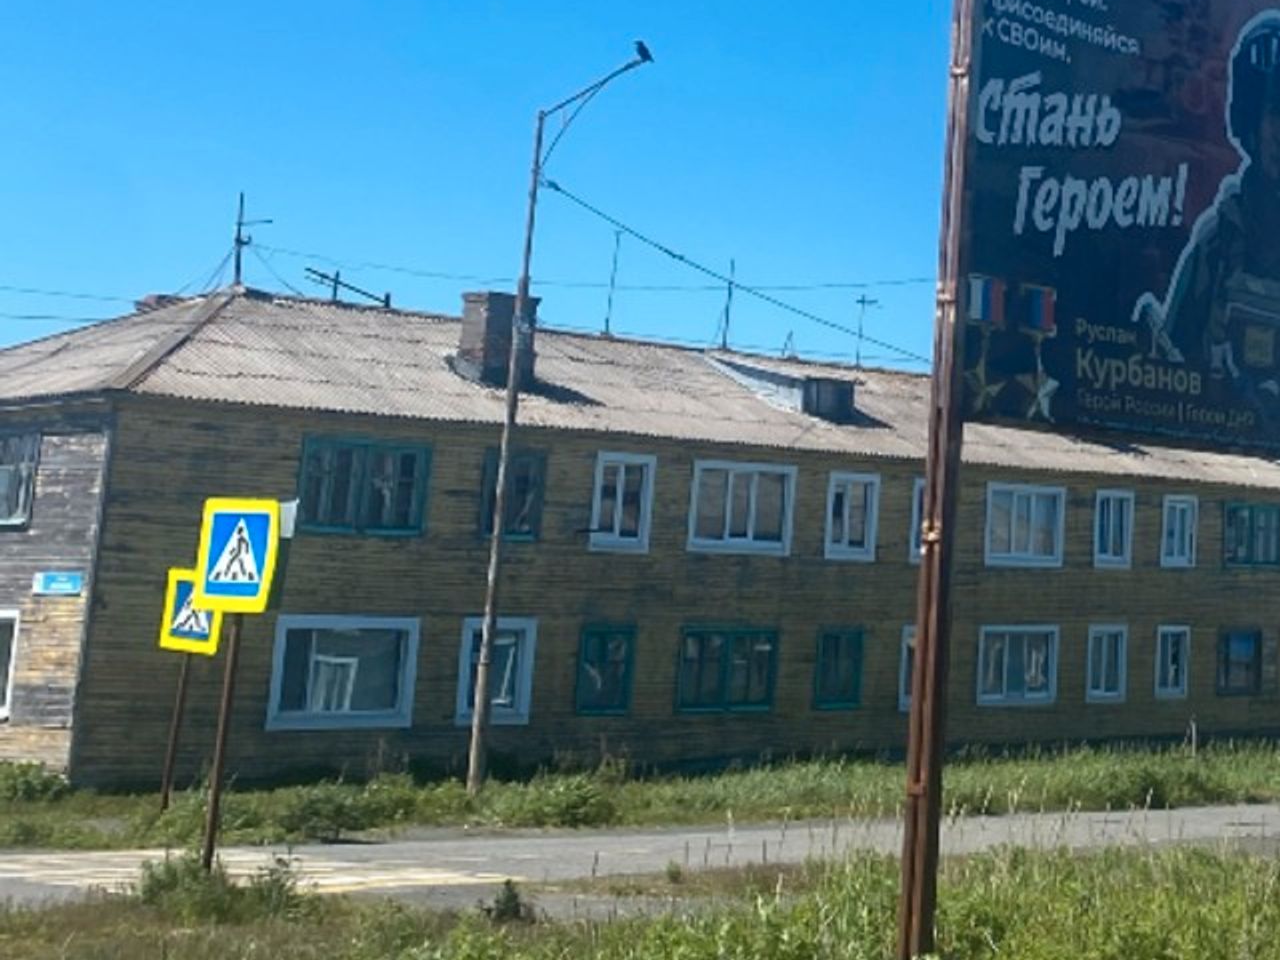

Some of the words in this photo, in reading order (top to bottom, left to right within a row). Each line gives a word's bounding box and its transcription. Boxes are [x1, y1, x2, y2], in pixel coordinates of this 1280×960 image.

[975, 71, 1122, 148] Стань
[1014, 163, 1188, 257] Героем!
[1075, 317, 1137, 344] Руслан
[1076, 347, 1202, 395] Курбанов
